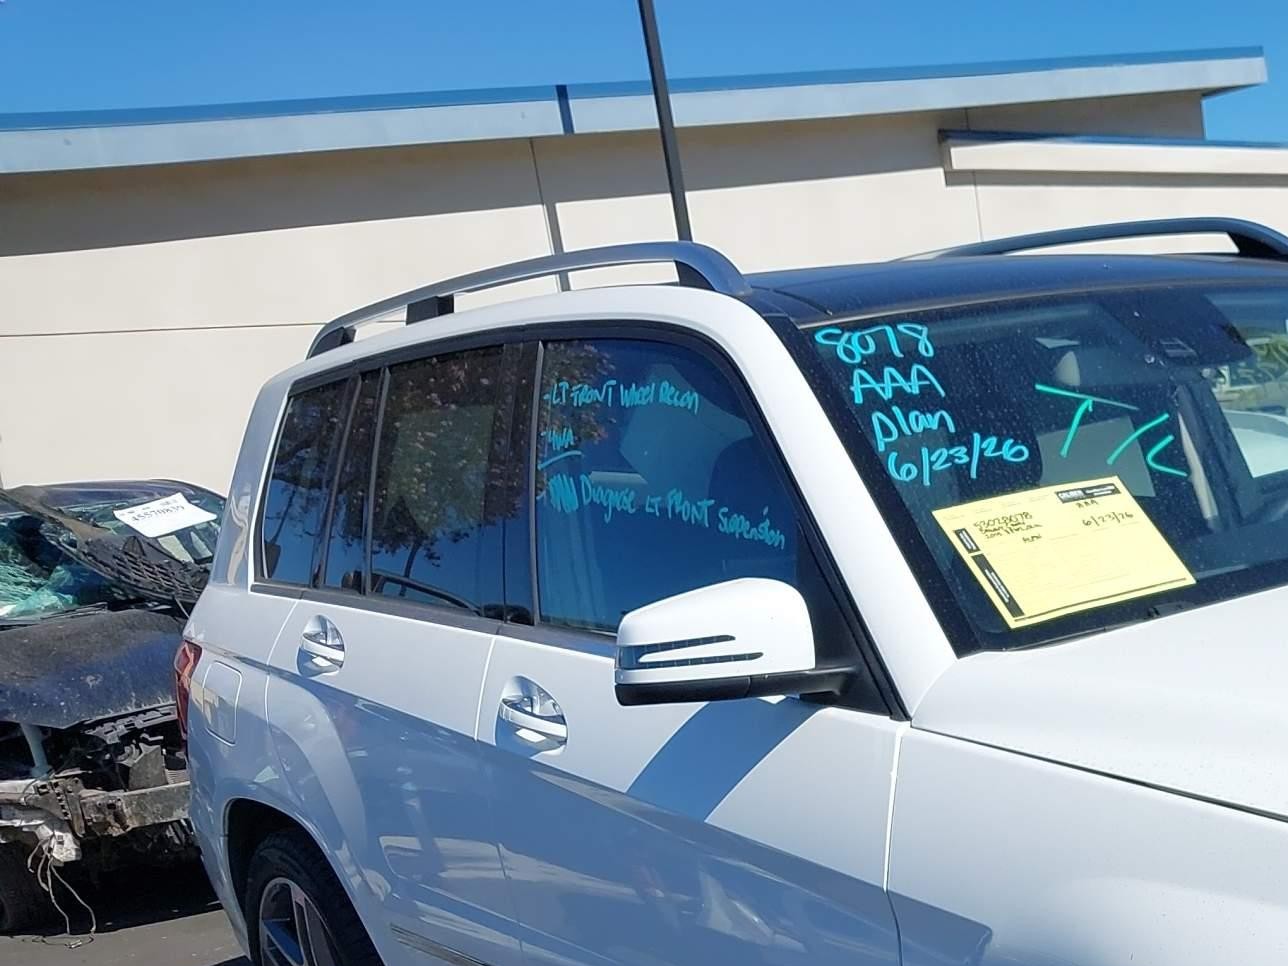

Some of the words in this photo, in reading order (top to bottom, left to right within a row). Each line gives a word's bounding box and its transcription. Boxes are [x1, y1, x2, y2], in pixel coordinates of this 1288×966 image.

[814, 322, 935, 364] 8078
[850, 362, 946, 404] AAA
[887, 432, 1030, 486] 6/23/26
[645, 495, 662, 517] LT
